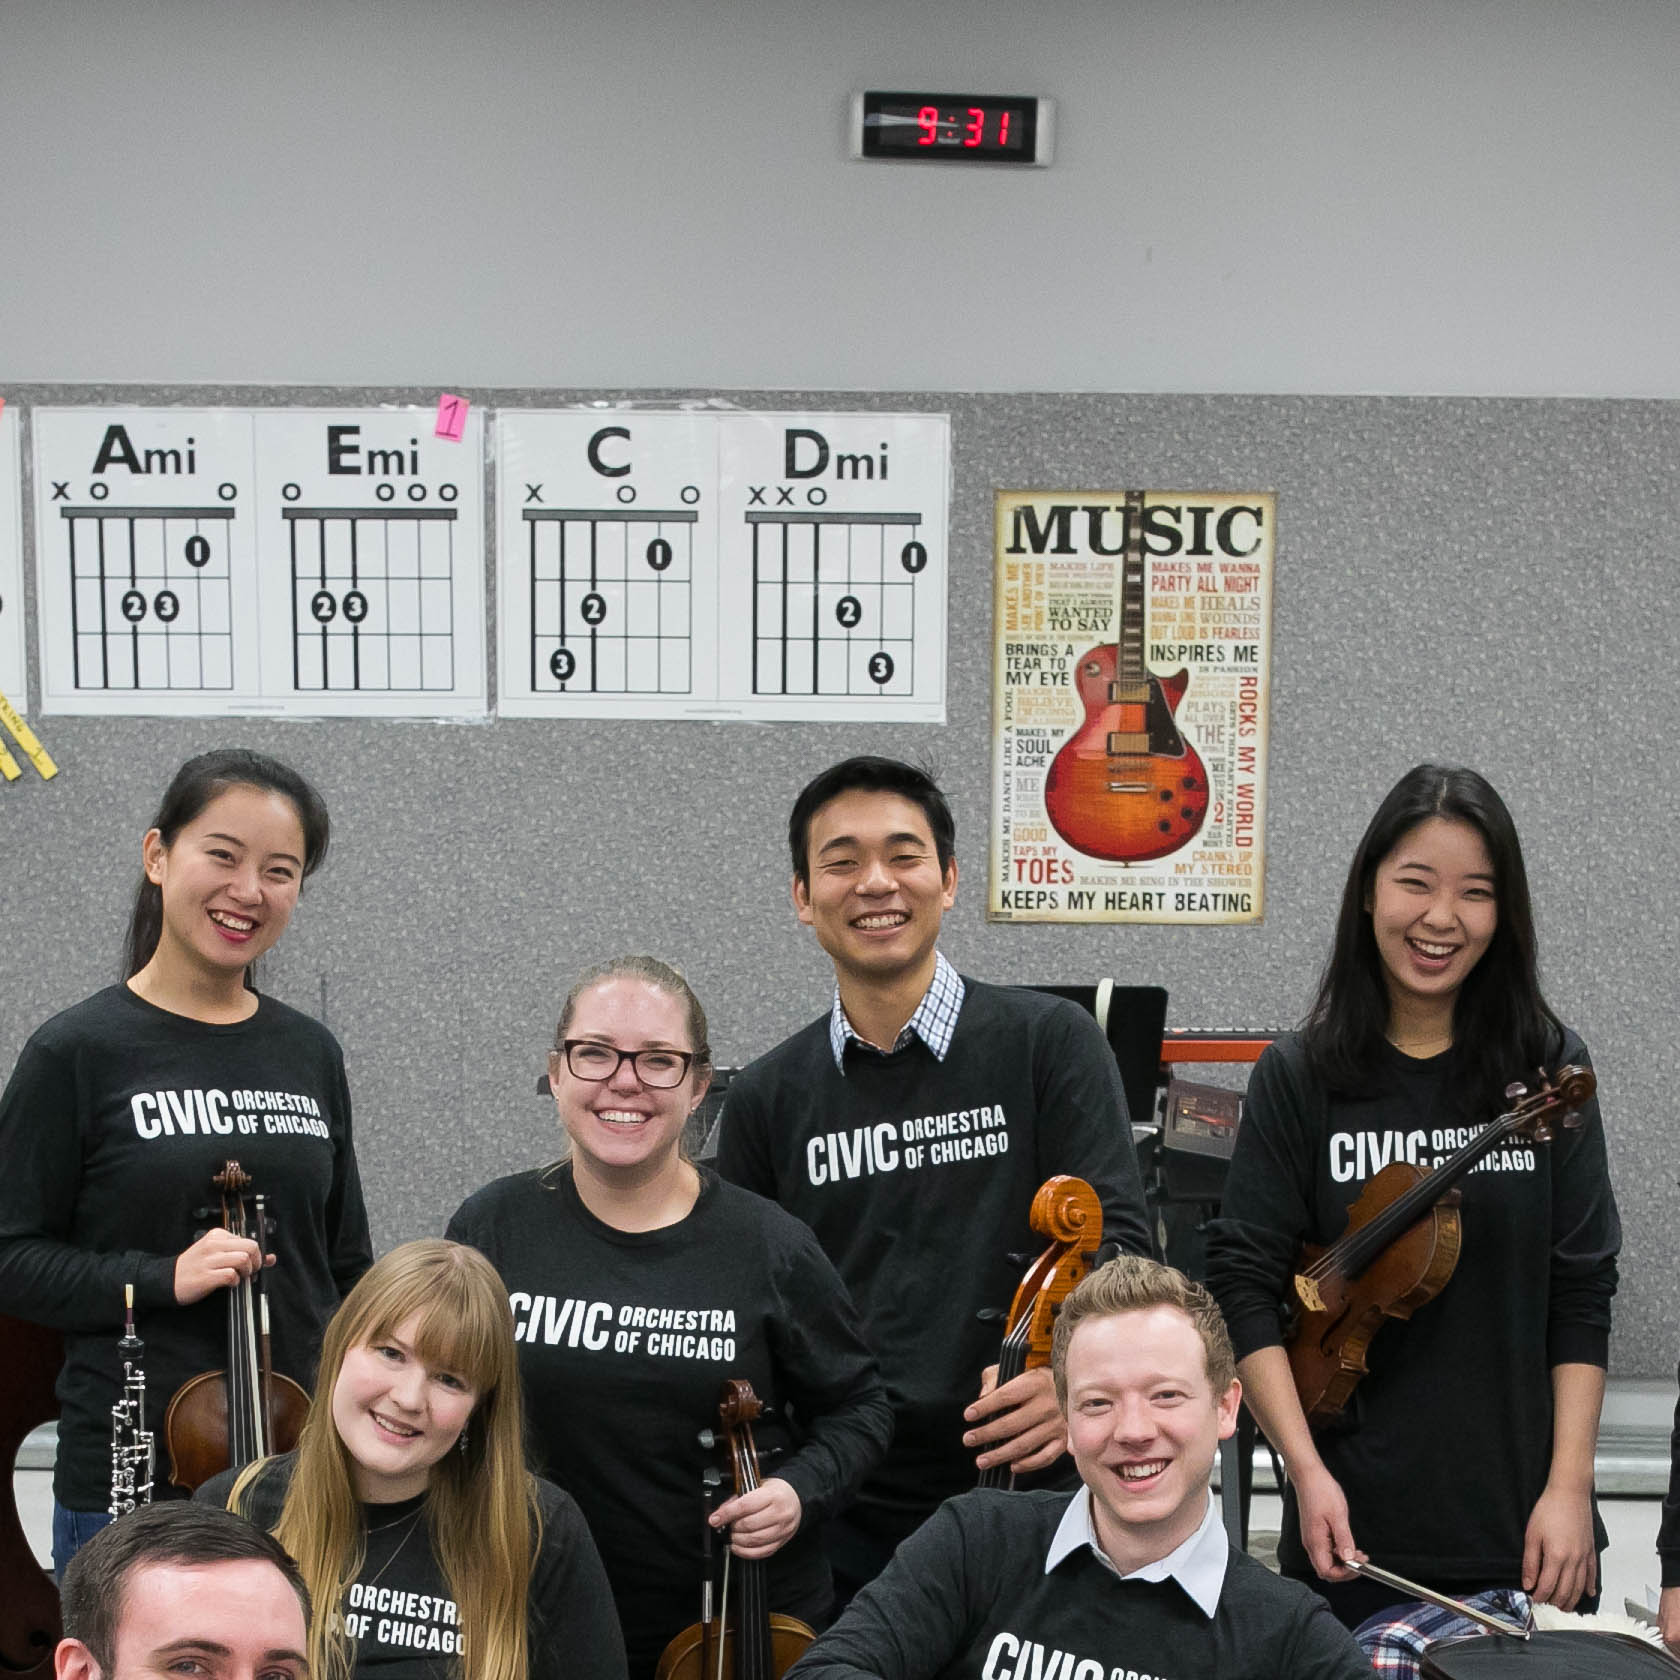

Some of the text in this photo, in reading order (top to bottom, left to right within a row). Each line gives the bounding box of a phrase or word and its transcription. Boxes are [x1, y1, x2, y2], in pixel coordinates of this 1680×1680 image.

[917, 106, 1011, 148] 9:31
[437, 400, 461, 438] 1
[92, 425, 195, 475] Ami
[327, 426, 419, 475] Emi
[587, 426, 631, 477] C
[785, 429, 888, 480] Dmi
[1006, 505, 1263, 557] MUSIC
[1151, 562, 1260, 573] MAKES ME WANNA
[1151, 575, 1259, 593] PARTY ALL NIGHT
[1048, 608, 1113, 618] WANTED
[1200, 596, 1261, 611] HEALS
[1048, 619, 1111, 631] TO SAY
[1200, 613, 1260, 624] WOUNDS
[1212, 627, 1260, 639] FEARLESS
[1005, 643, 1074, 656] BRINGS A
[1150, 645, 1258, 663] INSPIRES ME
[1007, 657, 1066, 670] TEAR TO
[1006, 672, 1069, 686] MY EYE
[1004, 688, 1013, 721] FOOL
[1187, 701, 1226, 712] PLAYS
[1017, 729, 1064, 737] MAKES MY
[1195, 724, 1225, 744] THE
[1004, 738, 1012, 766] LIKE
[1017, 739, 1054, 754] SOUL
[1016, 756, 1045, 767] ACHE
[1235, 676, 1258, 848] ROCKS MY WORLD
[1003, 770, 1012, 812] DANCE
[1002, 816, 1011, 834] ME
[1214, 802, 1224, 823] 2
[1013, 846, 1058, 856] TAPS MY
[1192, 851, 1253, 863] CRANKS UP
[1013, 858, 1074, 884] TOES
[1175, 864, 1252, 875] MY STEREO
[1207, 877, 1251, 888] SHOWER
[1002, 890, 1252, 912] KEEPS MY HEART BEATING
[130, 1089, 233, 1139] CIVIC
[231, 1090, 320, 1117] ORCHESTRA
[237, 1114, 329, 1139] OF CHICAGO
[902, 1104, 1006, 1141] ORCHESTRA
[807, 1122, 899, 1186] CIVIC
[904, 1131, 1009, 1169] OF CHICAGO
[1329, 1129, 1428, 1183] CIVIC
[1467, 1149, 1535, 1175] ICAGO
[508, 1292, 613, 1351] CIVIC
[618, 1305, 736, 1333] ORCHESTRA
[614, 1331, 736, 1362] OF CHICAGO
[345, 1613, 372, 1639] OF
